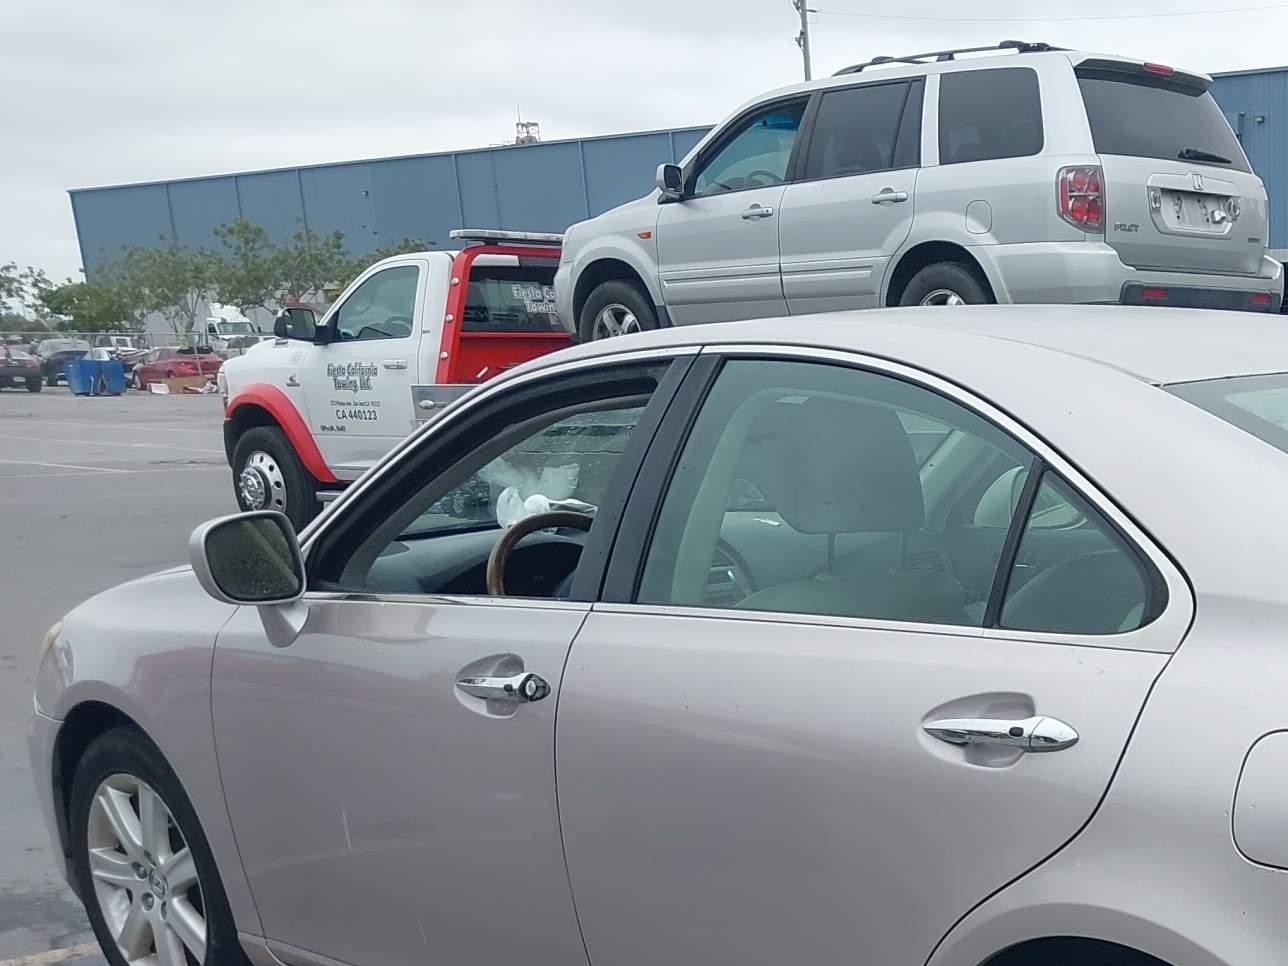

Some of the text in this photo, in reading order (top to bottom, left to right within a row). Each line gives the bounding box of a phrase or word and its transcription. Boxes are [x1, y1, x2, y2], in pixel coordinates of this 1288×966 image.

[512, 284, 542, 299] Fiesta
[327, 362, 378, 377] Fiesta California
[336, 409, 378, 421] CA 440123
